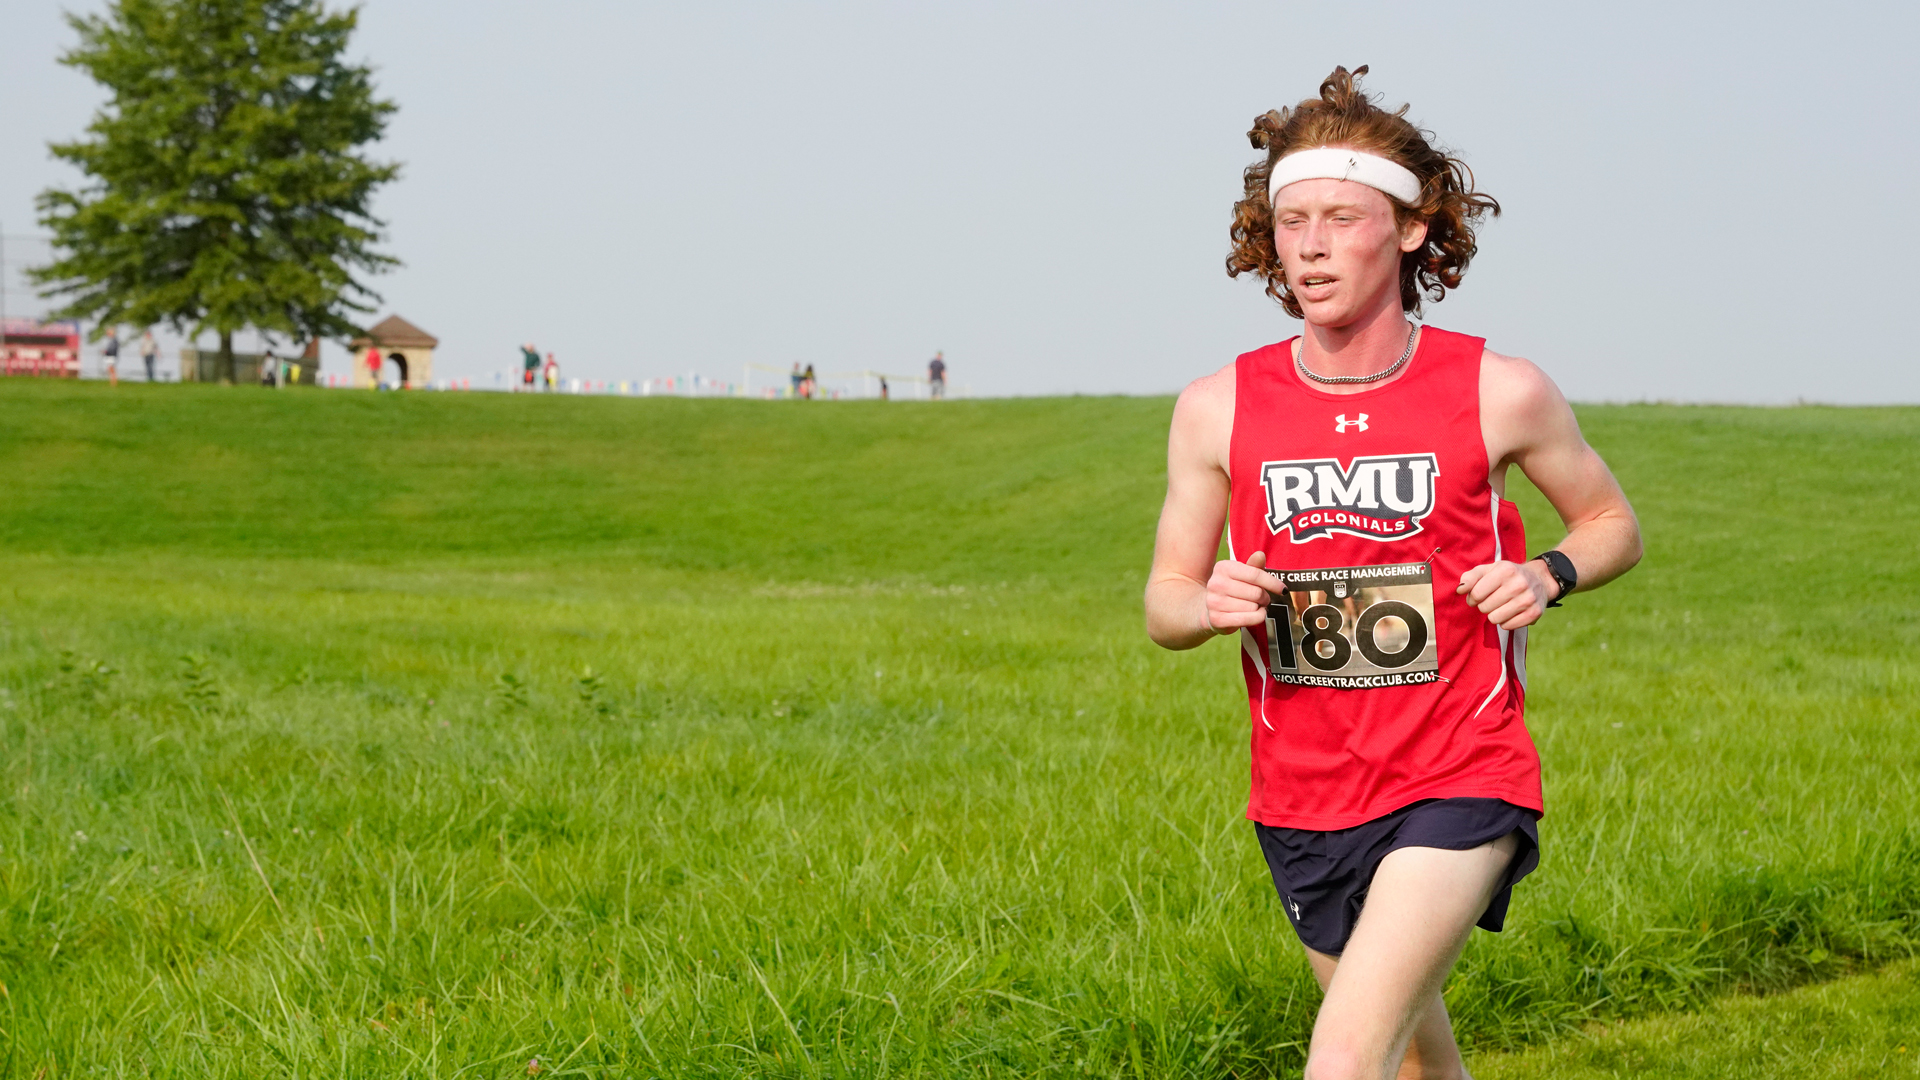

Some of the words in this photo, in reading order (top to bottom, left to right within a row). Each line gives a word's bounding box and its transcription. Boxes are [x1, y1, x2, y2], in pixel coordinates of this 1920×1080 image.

[1267, 460, 1431, 526] RMU
[1298, 512, 1405, 532] COLONIALS
[1268, 572, 1285, 582] OLF
[1287, 571, 1319, 582] CREEK
[1321, 570, 1349, 581] RACE
[1351, 565, 1426, 579] MANAGEMENT
[1267, 600, 1428, 672] 180
